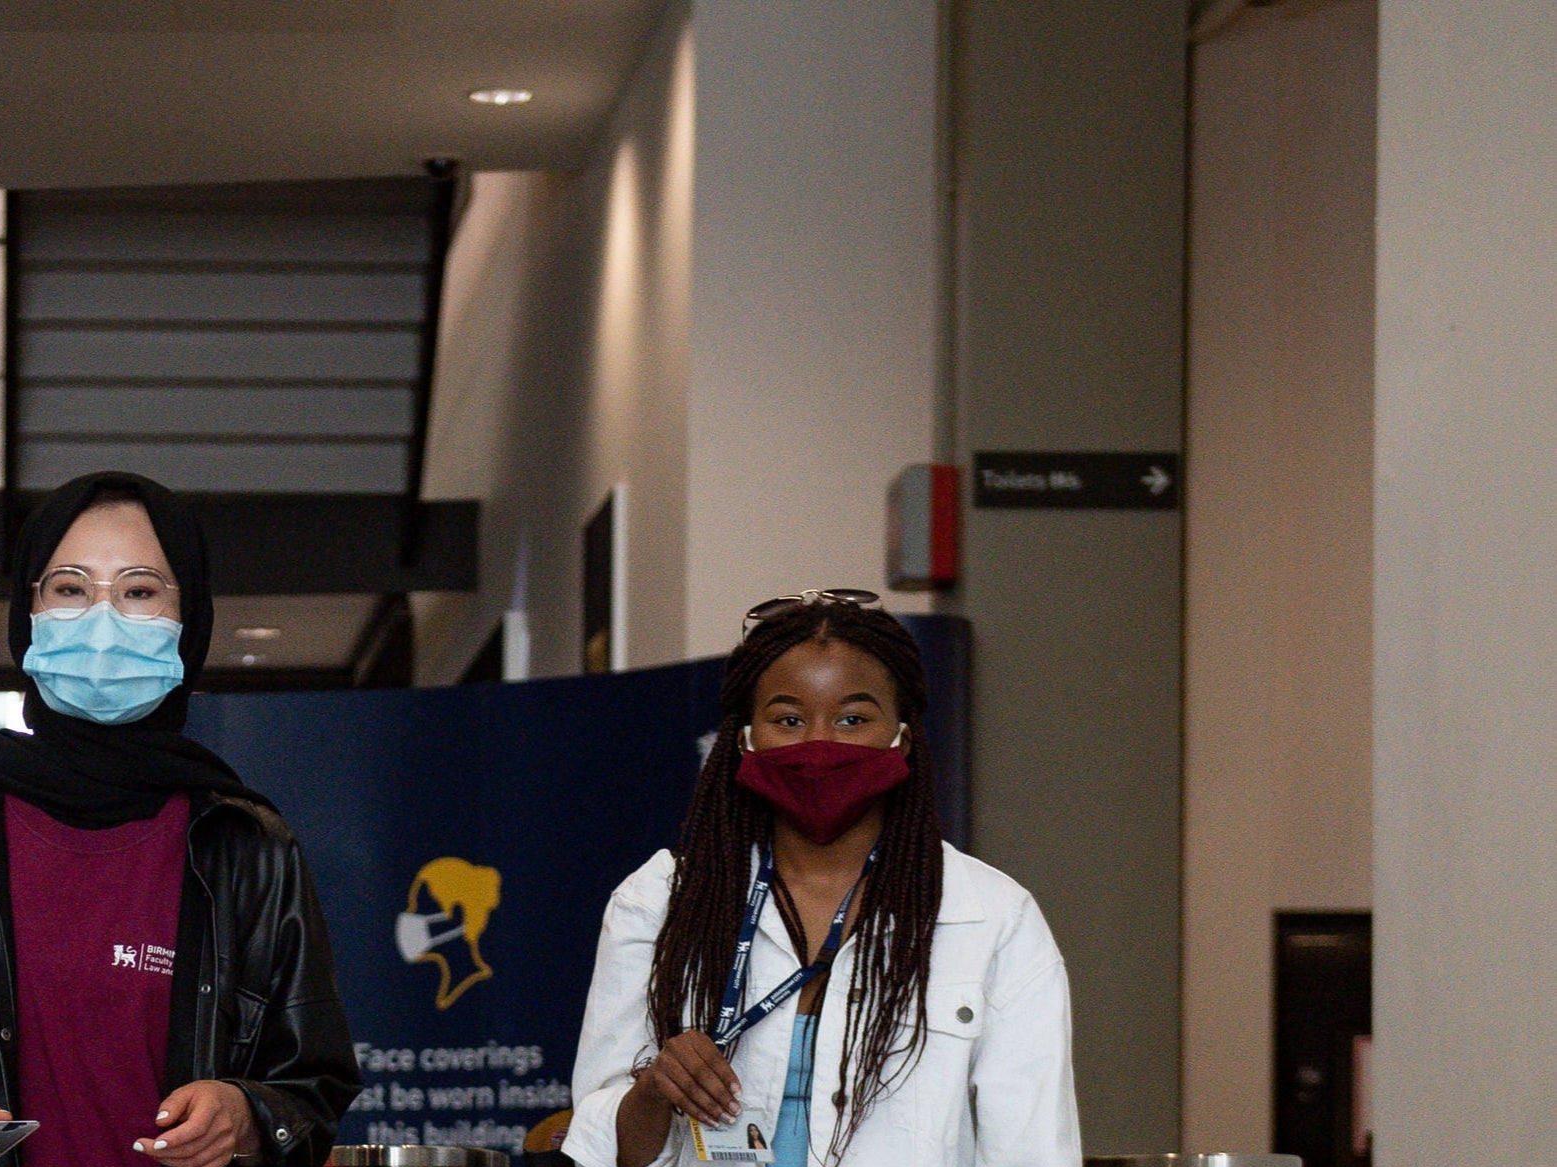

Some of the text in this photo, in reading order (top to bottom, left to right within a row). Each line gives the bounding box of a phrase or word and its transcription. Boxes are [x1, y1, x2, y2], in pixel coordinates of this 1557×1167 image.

[144, 963, 161, 972] Law
[145, 955, 173, 967] Faculty
[353, 1040, 542, 1076] Face coverings
[390, 1081, 425, 1111] be
[426, 1086, 495, 1111] worn
[498, 1079, 572, 1109] inside
[367, 1120, 526, 1156] this building
